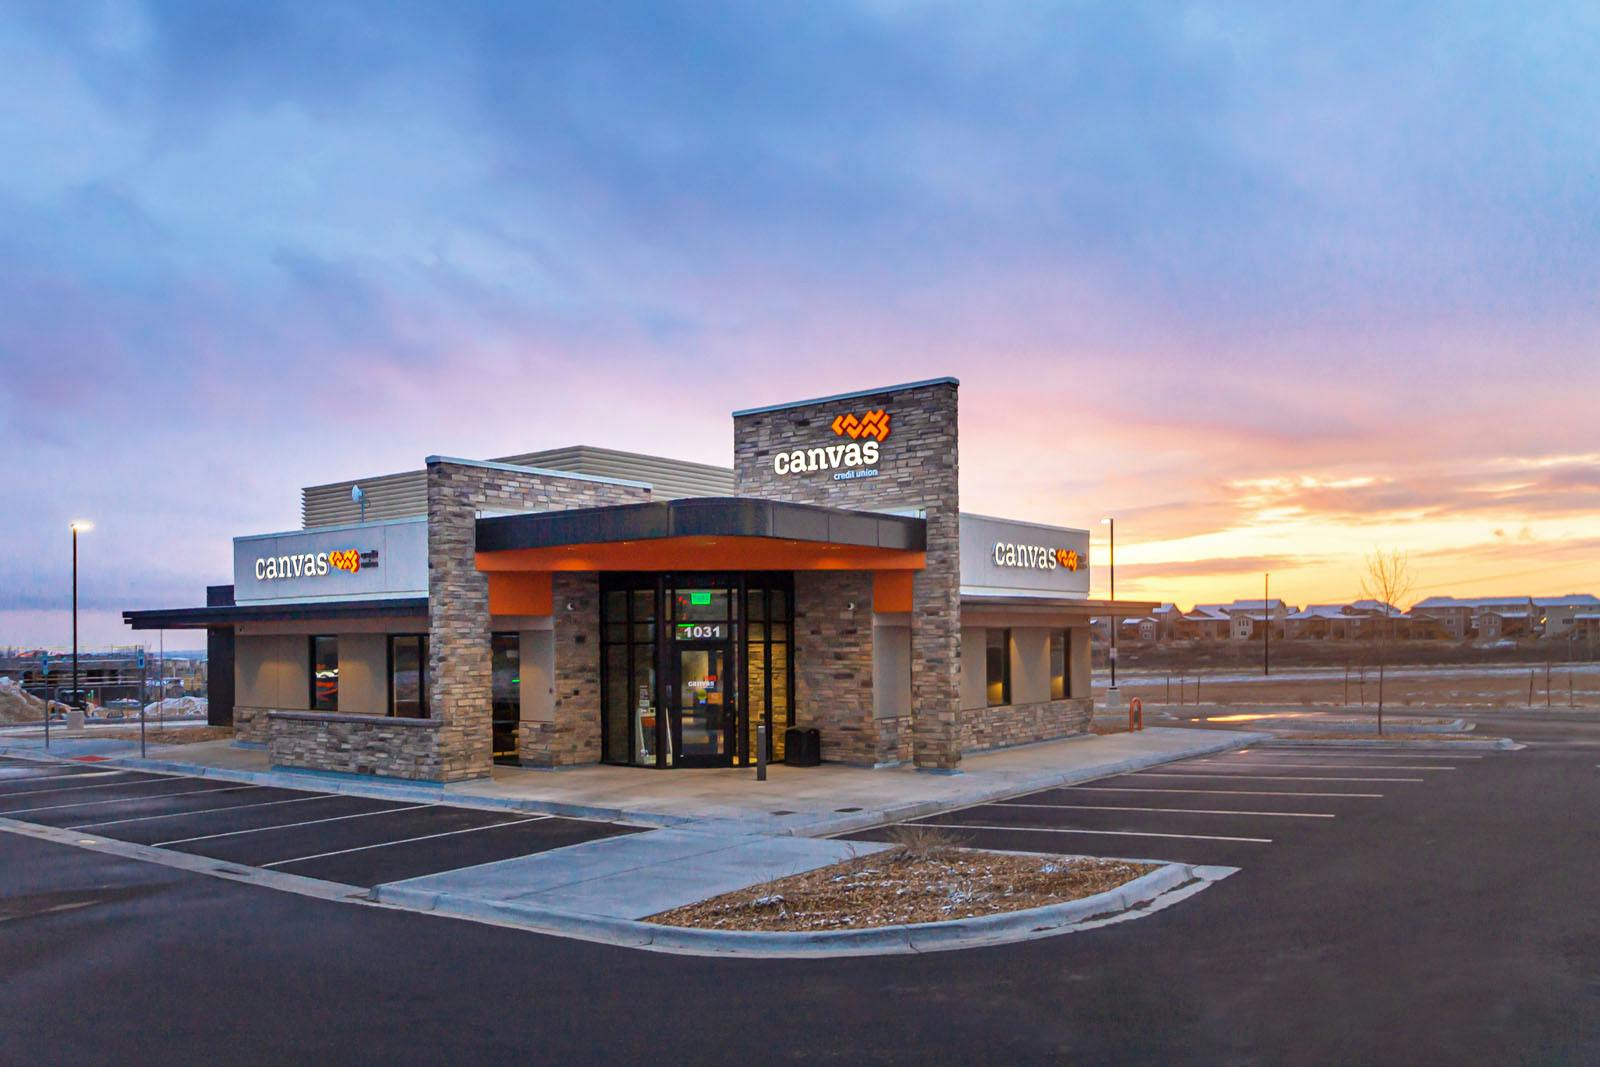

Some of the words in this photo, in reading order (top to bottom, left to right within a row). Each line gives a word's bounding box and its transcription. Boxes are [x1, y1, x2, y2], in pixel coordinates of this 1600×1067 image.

[774, 440, 880, 475] canvas
[833, 470, 856, 480] credit
[856, 468, 878, 477] union
[255, 552, 329, 580] canvas
[995, 542, 1057, 569] canvas
[684, 626, 720, 638] 1031
